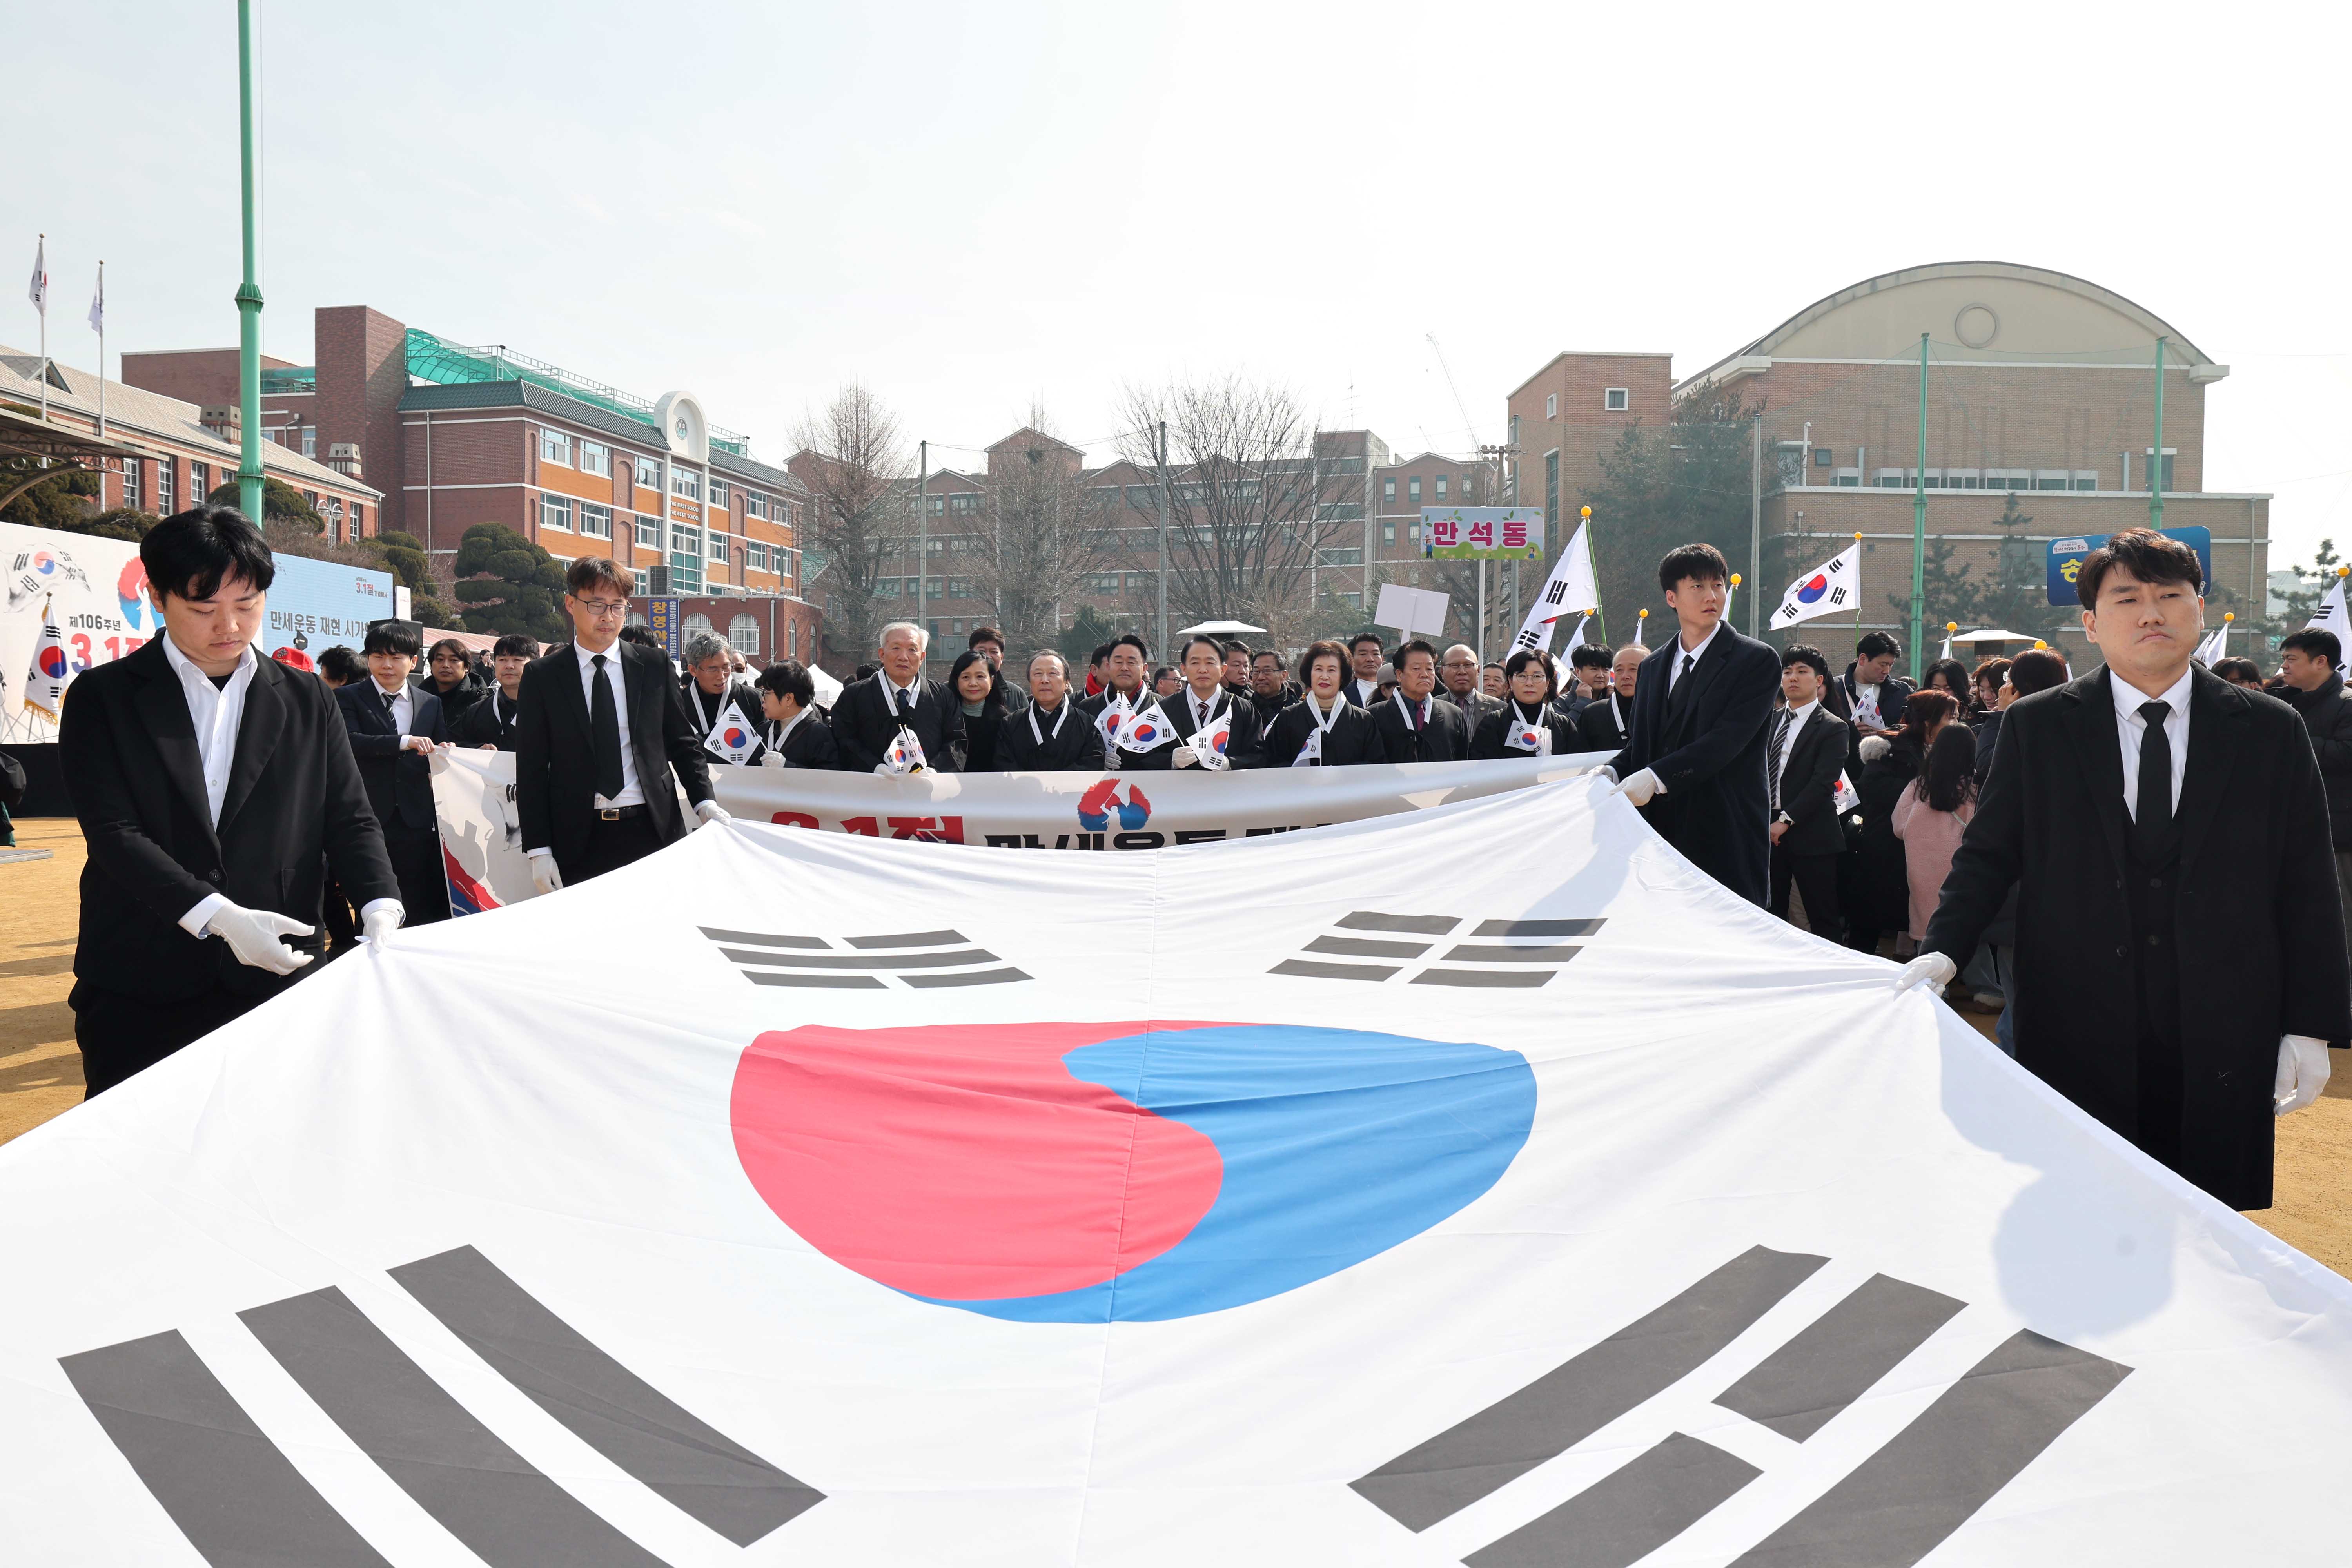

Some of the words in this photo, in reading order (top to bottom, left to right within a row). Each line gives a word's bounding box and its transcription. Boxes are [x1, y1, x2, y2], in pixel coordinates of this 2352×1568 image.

[356, 582, 374, 596] 3.1절
[69, 613, 121, 631] 제106주년
[270, 611, 316, 634] 만세운동
[320, 617, 340, 636] 재현
[652, 602, 667, 650] 창영야
